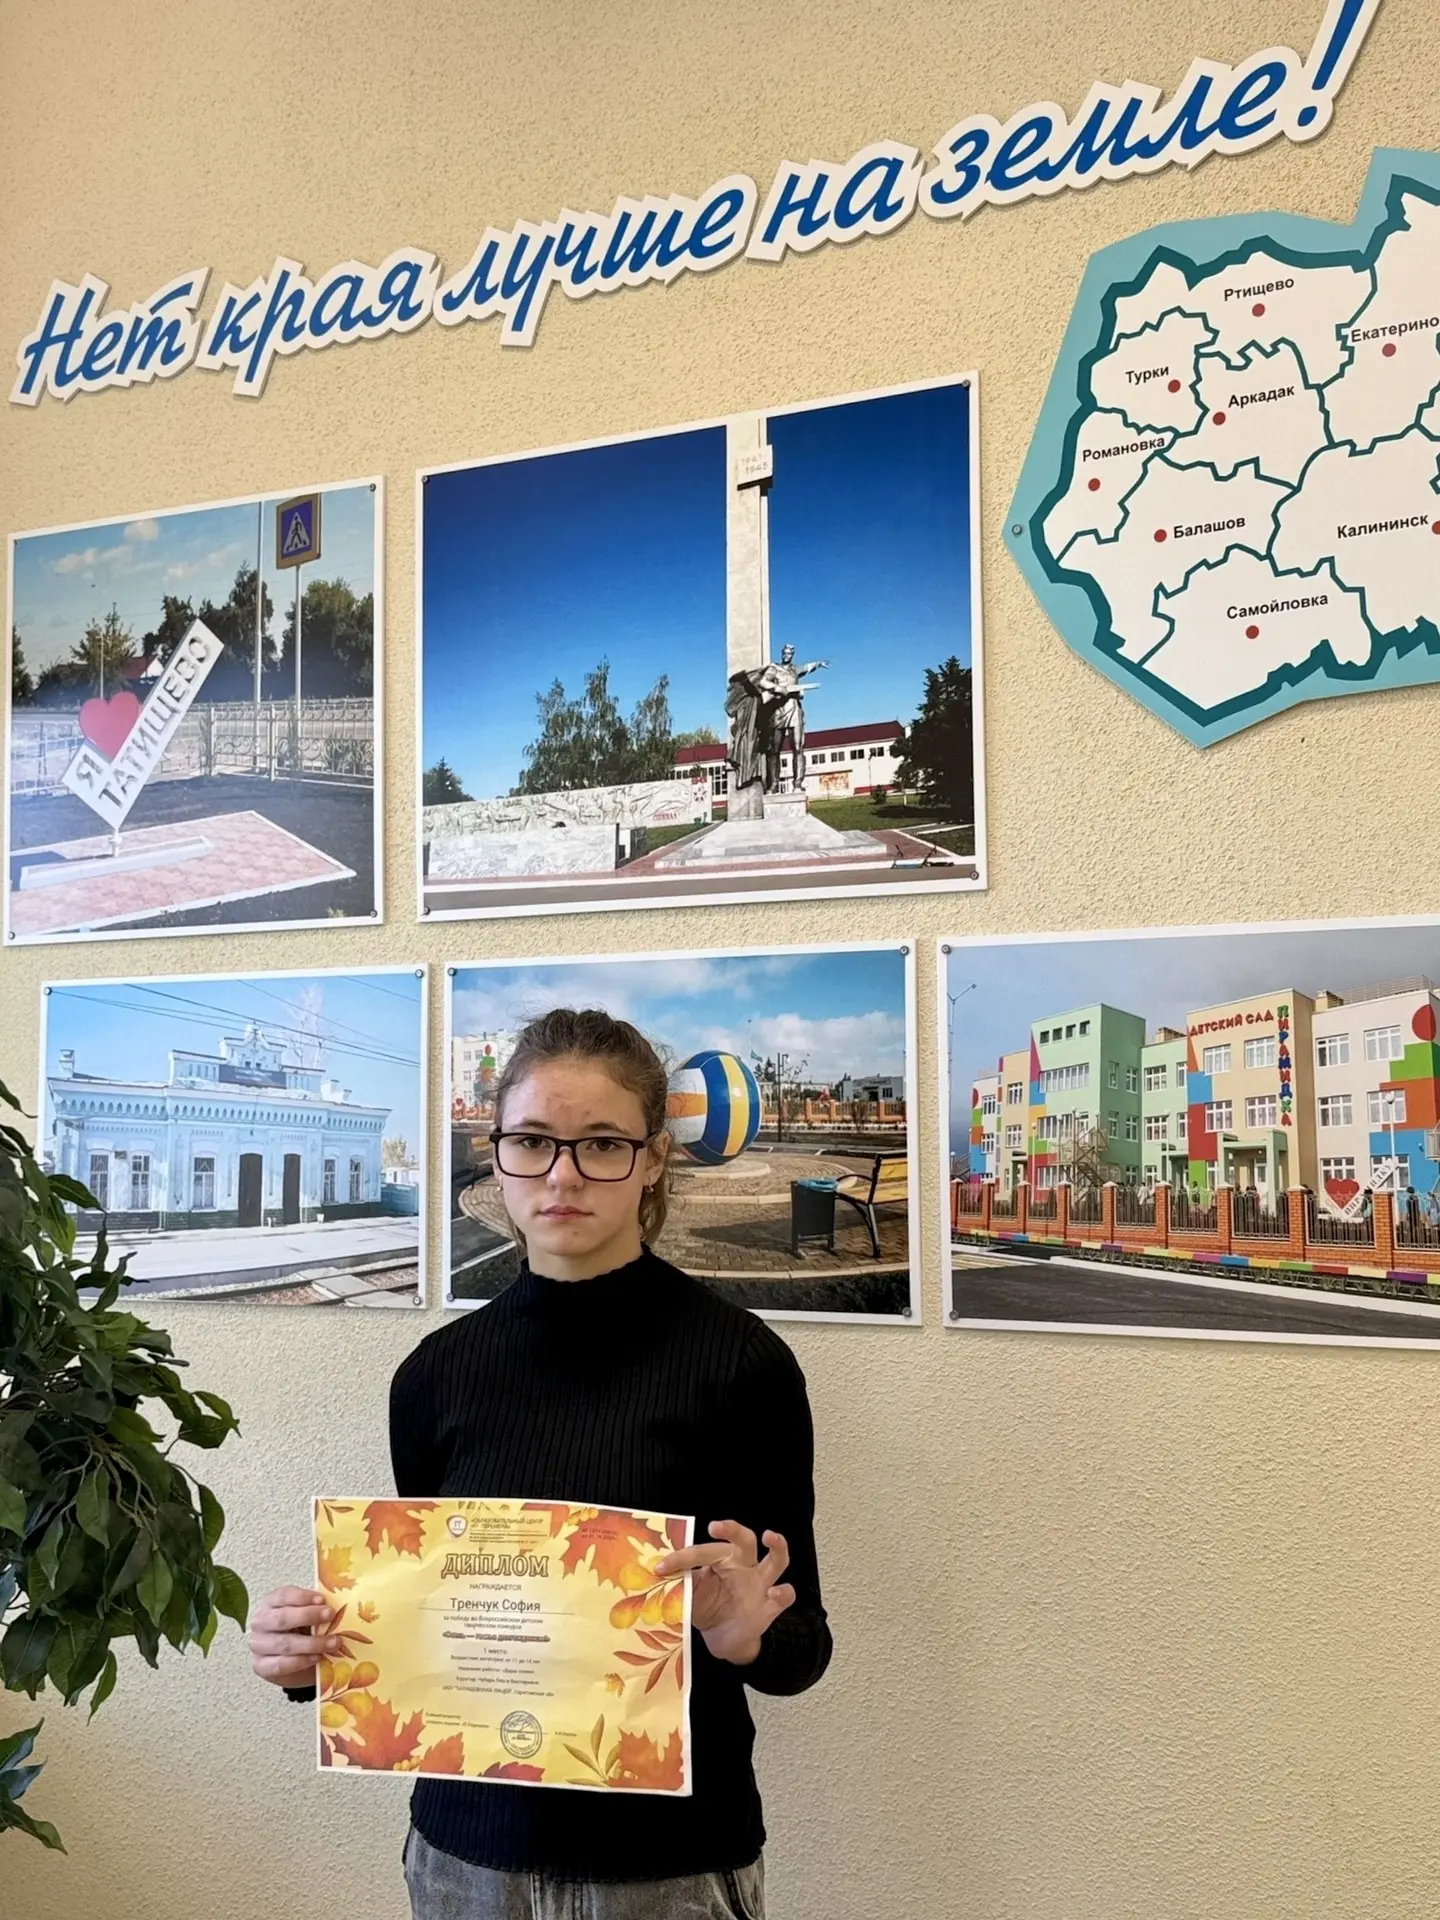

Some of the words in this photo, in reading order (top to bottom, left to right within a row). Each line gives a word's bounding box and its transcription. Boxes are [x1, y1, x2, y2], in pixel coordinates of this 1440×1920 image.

[20, 281, 194, 395] Нет
[207, 260, 424, 384] края
[441, 187, 745, 333] лучше
[761, 155, 905, 244] на
[928, 0, 1366, 205] земле!
[1223, 277, 1295, 302] Ртищево
[1351, 316, 1440, 343] Екатерино
[1125, 365, 1170, 385] Турки
[1228, 384, 1296, 408] Аркадак
[1082, 435, 1166, 462] Романовка
[1172, 514, 1246, 540] Балашов
[1336, 513, 1429, 539] Калининск
[1226, 592, 1329, 620] Самойловка
[98, 635, 211, 809] ТАТИЩЕВО
[76, 753, 103, 790] Я
[1189, 1013, 1243, 1037] ДЕТСКИЙ
[1245, 1009, 1275, 1025] САД
[1277, 1005, 1293, 1127] ПИРАМИДКА
[441, 1553, 549, 1579] ДИПЛОМ
[469, 1583, 522, 1591] НАГРАЖДАЕТСЯ
[450, 1597, 500, 1612] Тренчук
[502, 1598, 541, 1613] София
